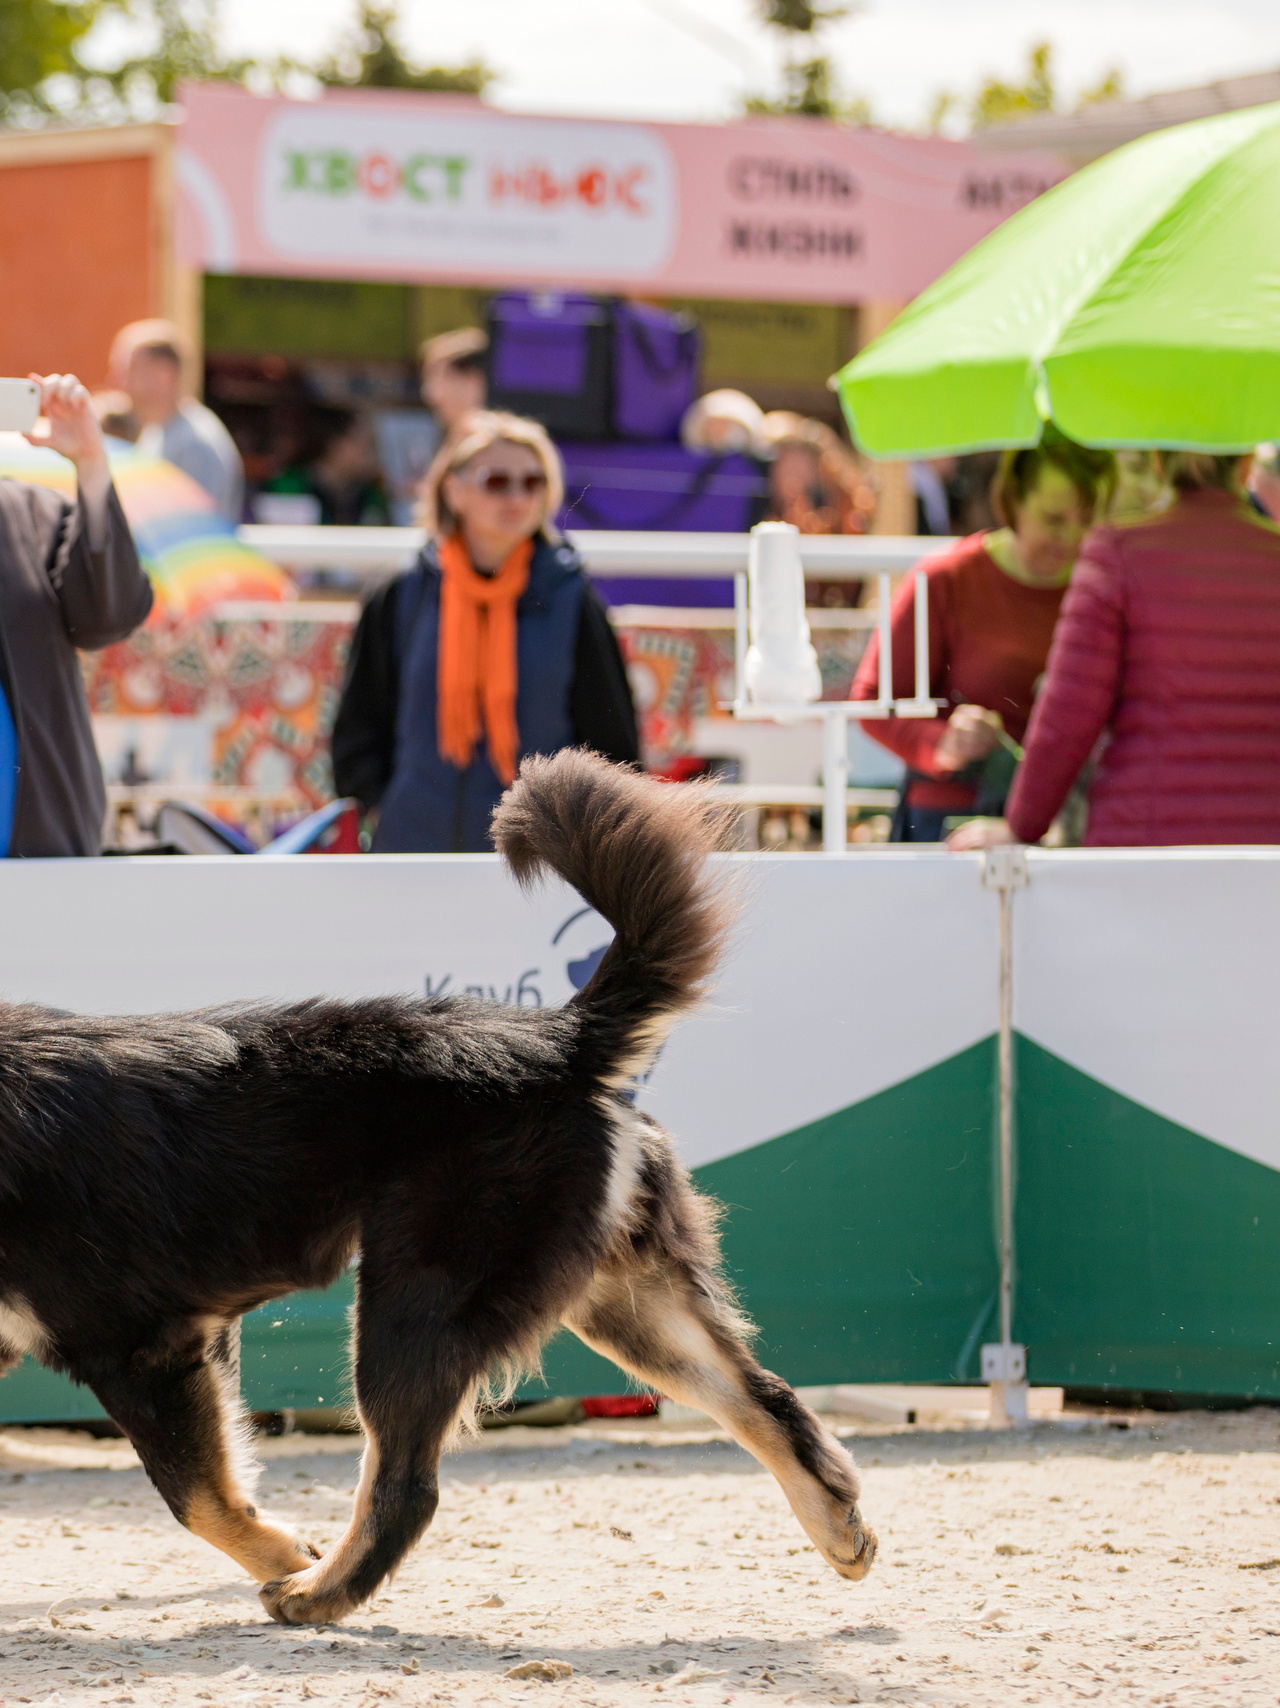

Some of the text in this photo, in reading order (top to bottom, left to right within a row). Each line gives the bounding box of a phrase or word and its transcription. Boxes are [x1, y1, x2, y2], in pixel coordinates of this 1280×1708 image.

[282, 147, 470, 205] ХВОСТ
[728, 158, 859, 205] СТИЛЬ
[728, 219, 863, 261] ЖИЗНИ
